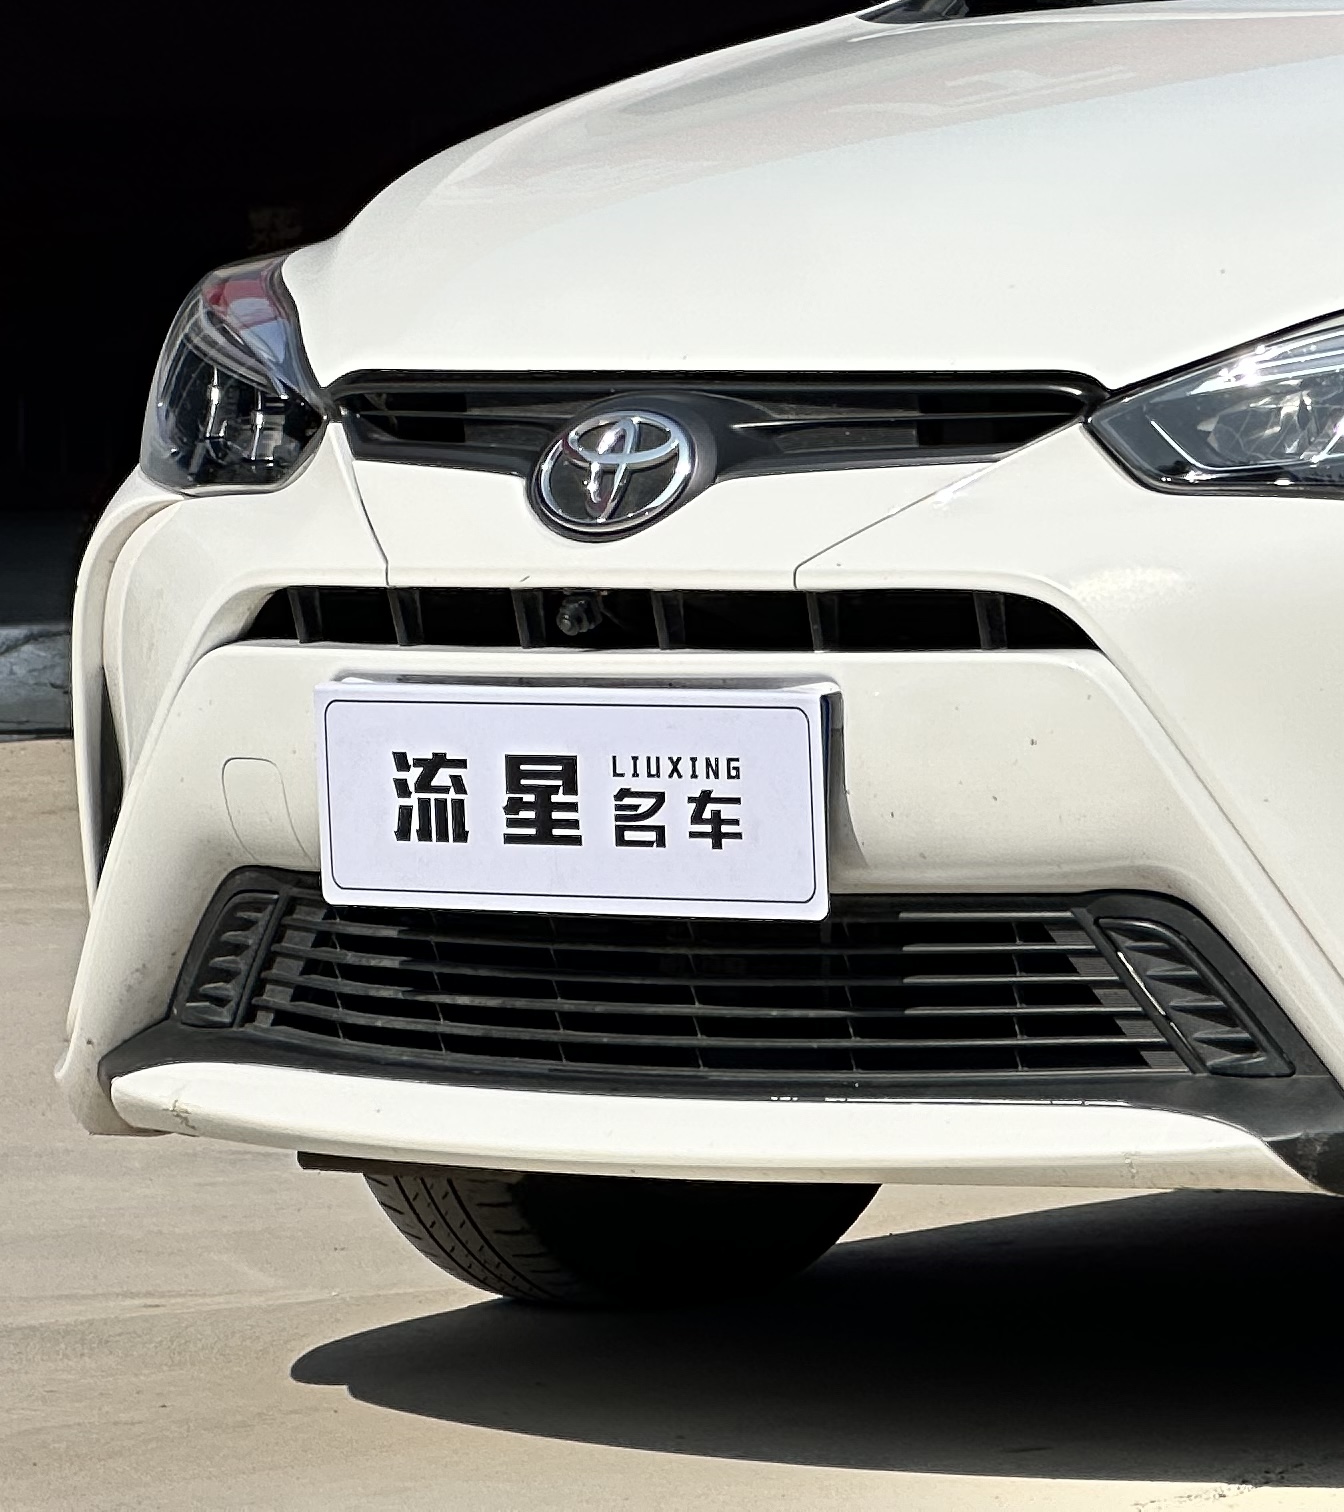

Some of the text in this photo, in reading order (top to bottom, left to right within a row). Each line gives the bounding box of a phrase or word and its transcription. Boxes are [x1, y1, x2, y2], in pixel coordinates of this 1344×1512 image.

[393, 751, 582, 847] 流星
[611, 755, 742, 781] LIUXING
[613, 787, 743, 850] 名车
